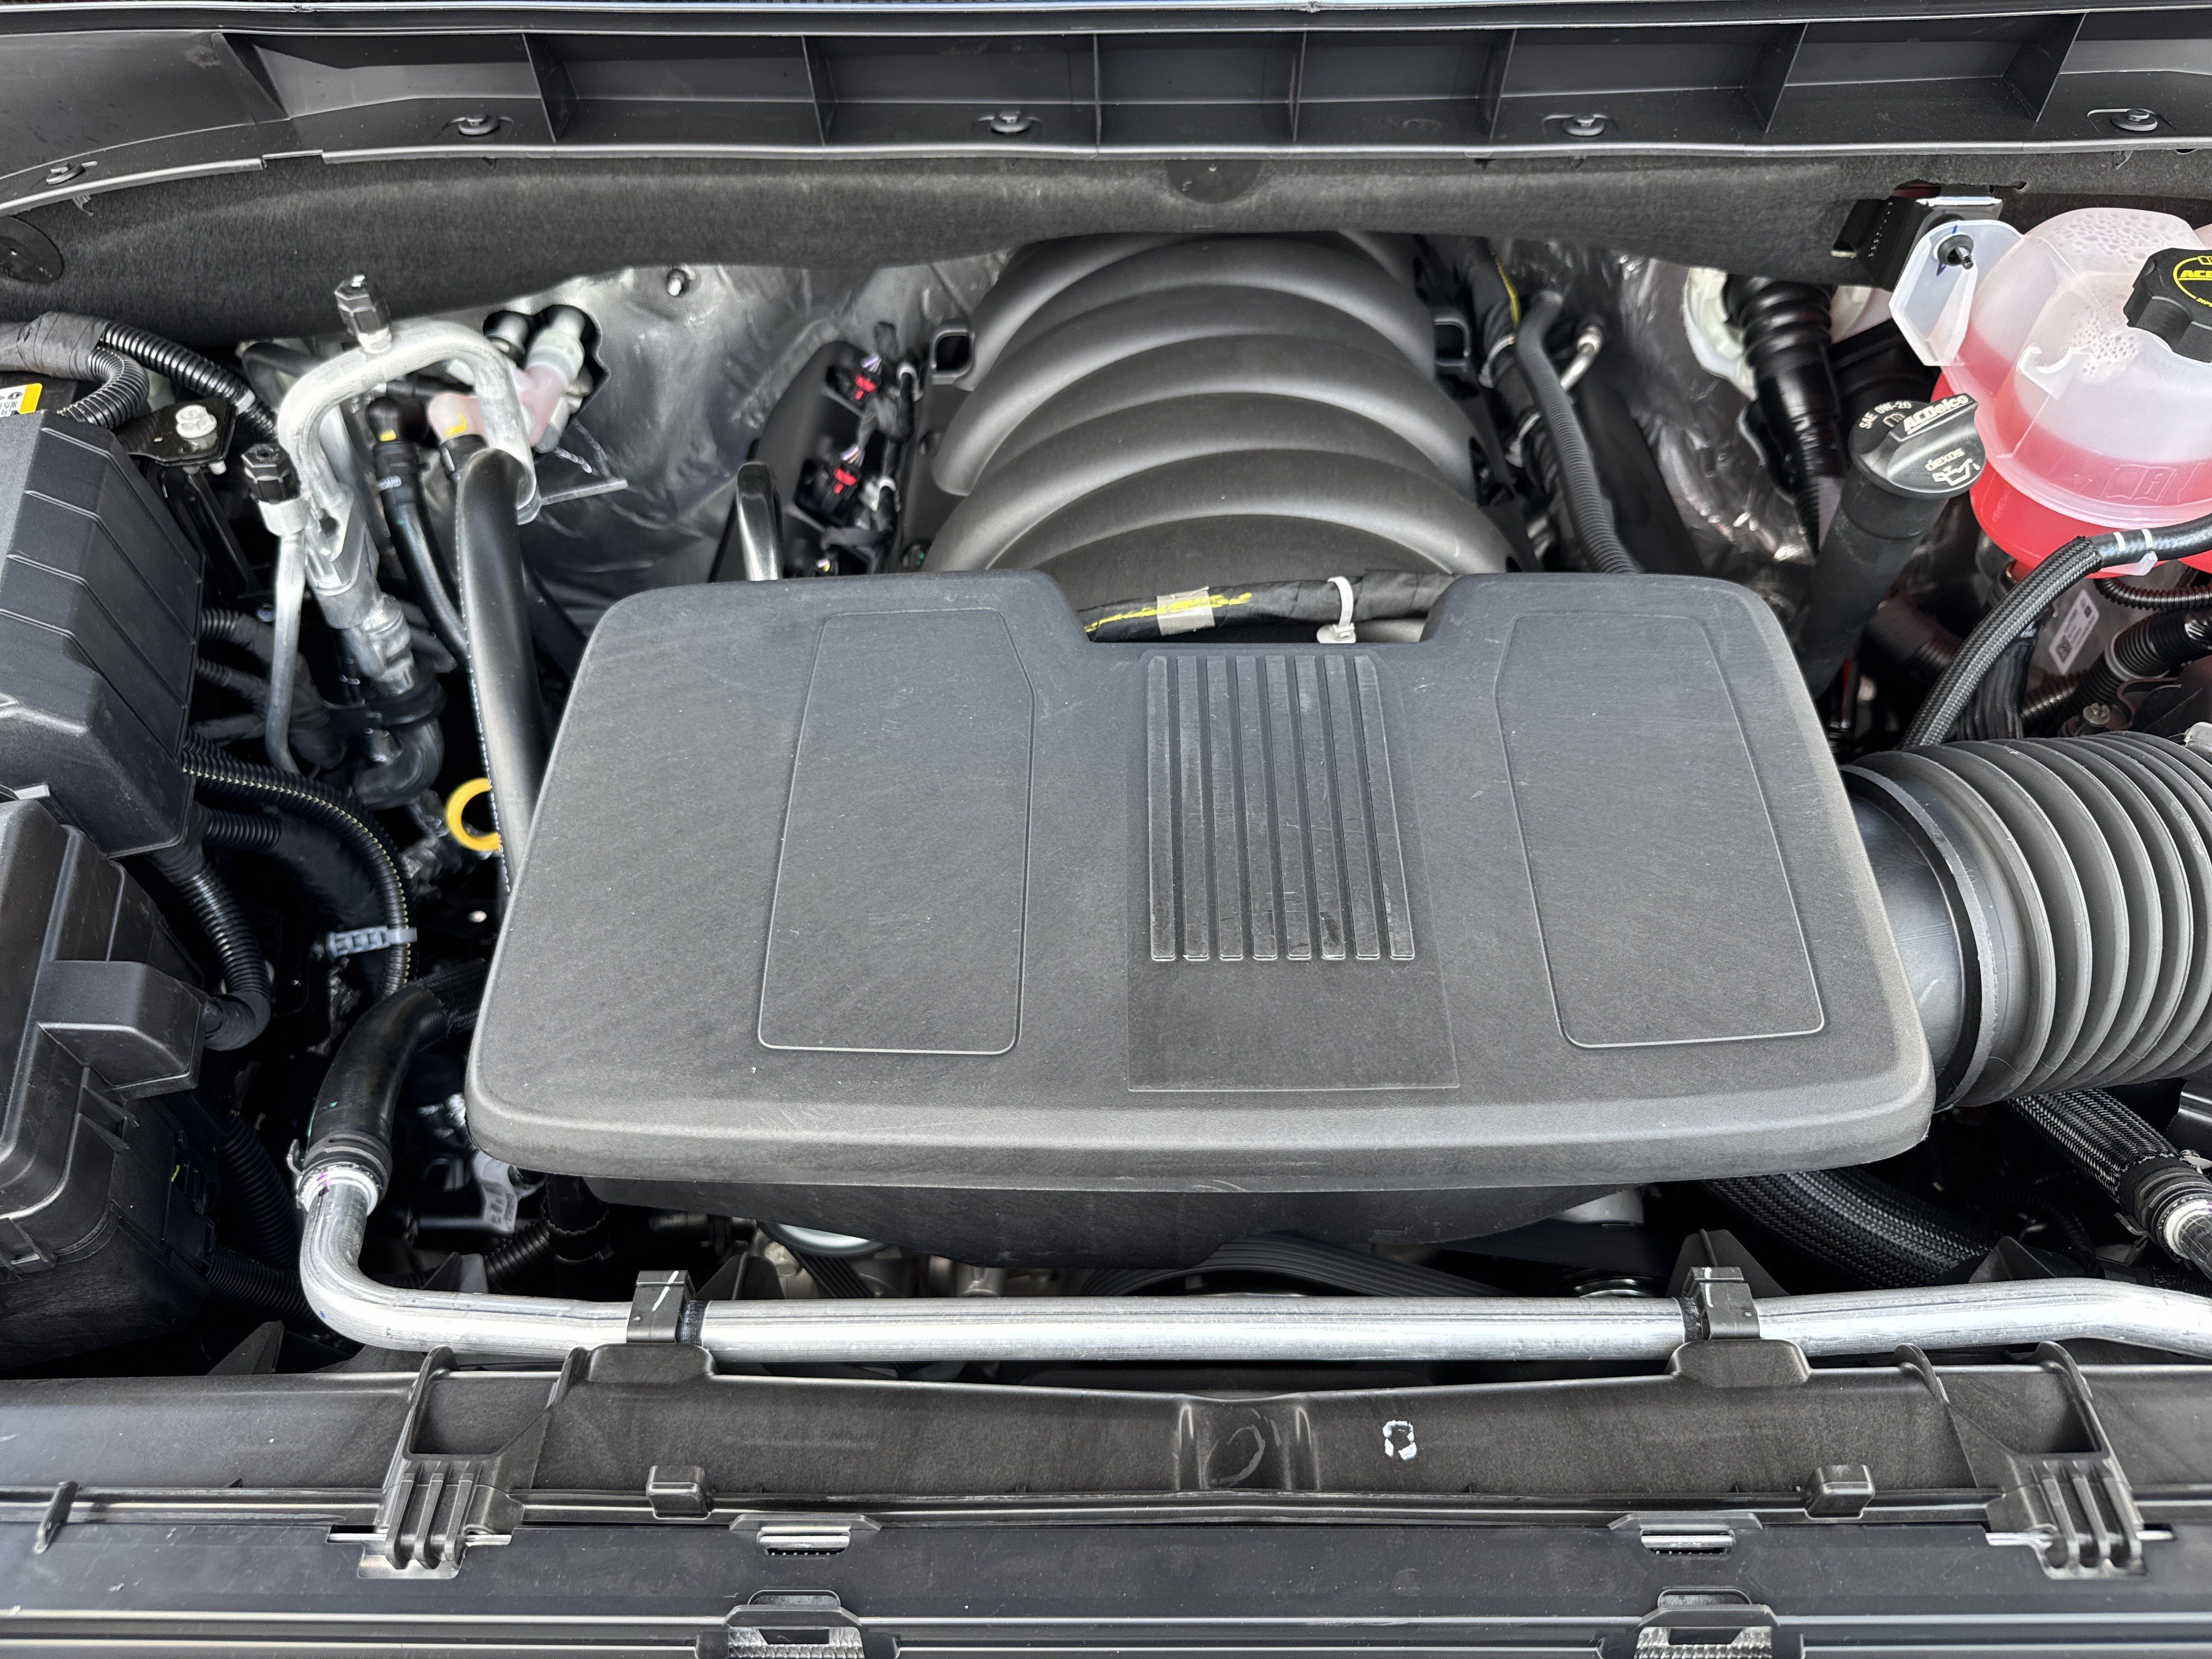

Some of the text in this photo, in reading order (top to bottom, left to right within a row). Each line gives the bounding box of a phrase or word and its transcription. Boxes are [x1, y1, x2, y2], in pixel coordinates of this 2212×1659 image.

[1859, 400, 1912, 429] SAE 0W-20
[1903, 394, 1969, 432] ACDelco
[1925, 447, 1966, 472] dexos
